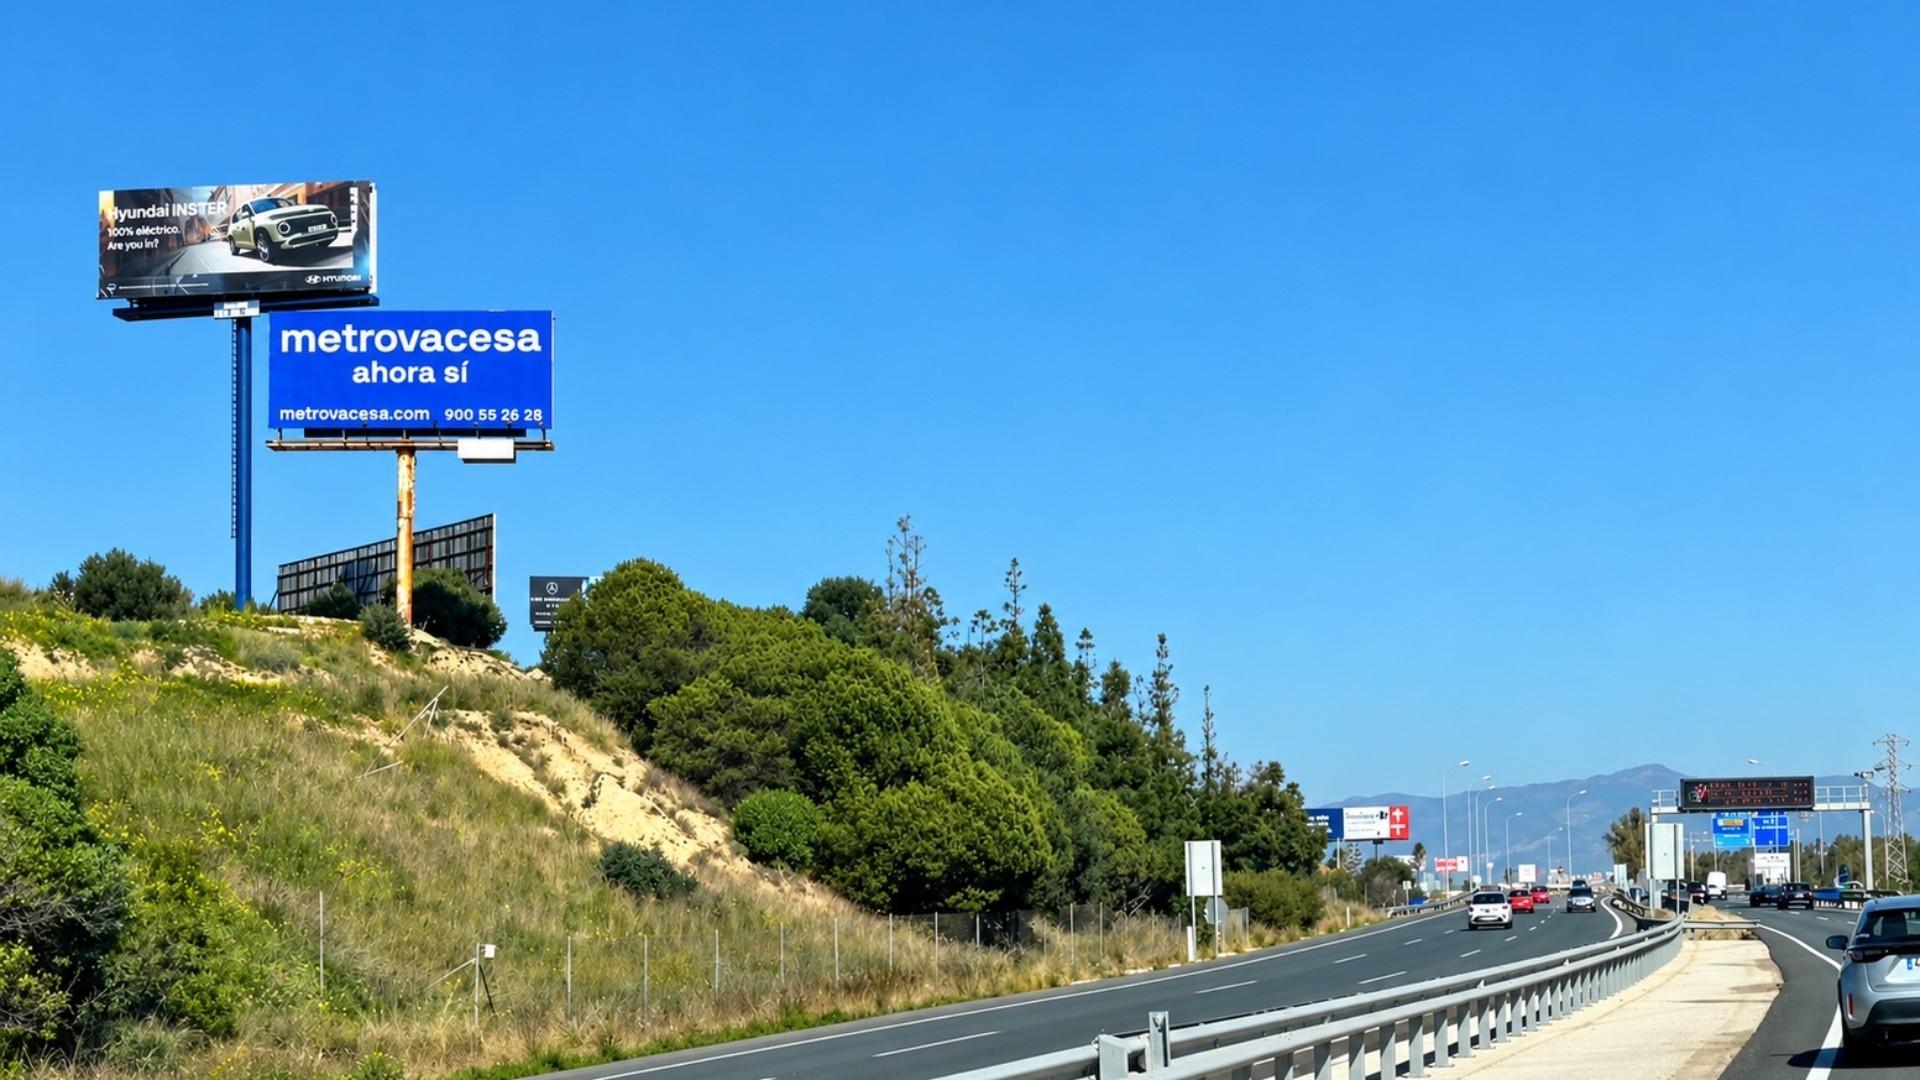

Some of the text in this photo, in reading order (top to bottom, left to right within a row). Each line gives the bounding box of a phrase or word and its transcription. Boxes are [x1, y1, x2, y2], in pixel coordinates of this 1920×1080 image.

[107, 202, 227, 223] Hyundai INSTER
[107, 227, 134, 237] 100%
[107, 239, 159, 252] Are you in?
[281, 323, 542, 353] metrovacesa
[352, 360, 469, 383] ahora sí
[279, 406, 543, 421] metrovacesa.com 900 55 26 28
